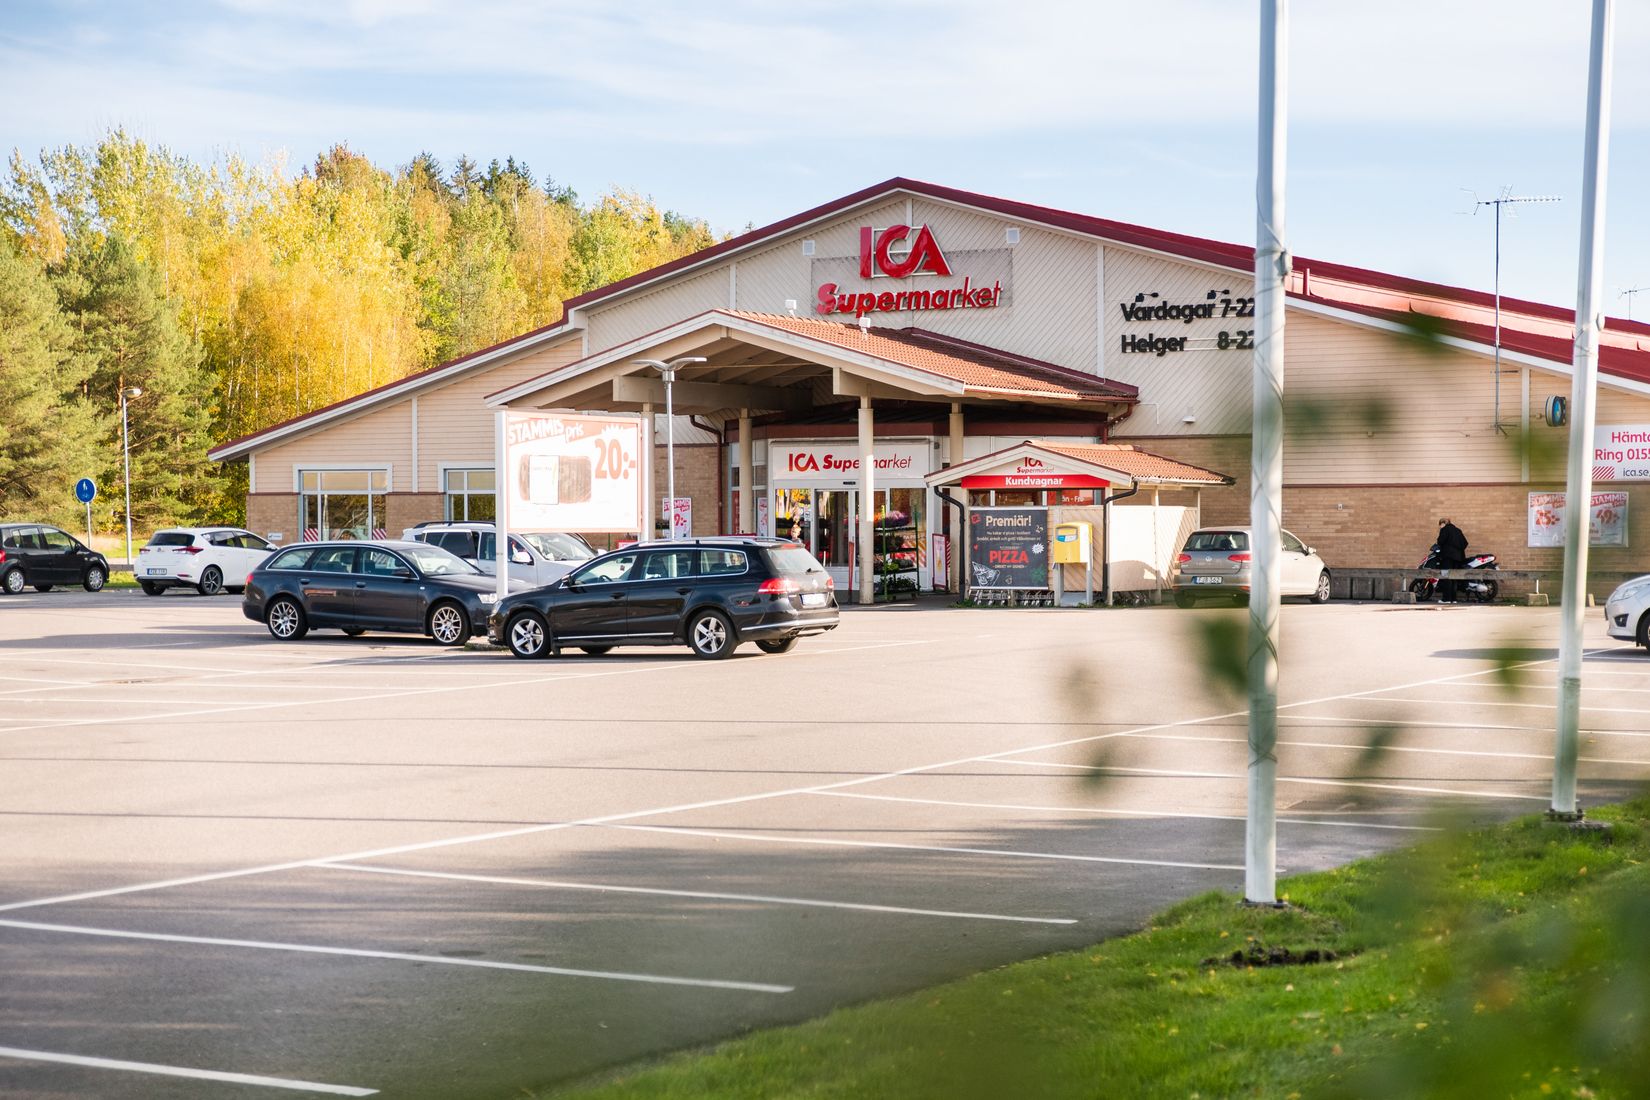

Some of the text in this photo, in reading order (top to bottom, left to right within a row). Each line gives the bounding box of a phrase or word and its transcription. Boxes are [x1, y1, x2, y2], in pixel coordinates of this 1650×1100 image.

[860, 223, 952, 279] ICA
[816, 277, 1002, 318] Supermarket
[1121, 301, 1215, 324] Vardagar
[1121, 333, 1187, 357] Helger
[509, 419, 564, 445] STAMMIS
[565, 423, 584, 443] pris
[594, 438, 636, 479] 20:-
[789, 453, 912, 472] ICA Supearket
[1024, 457, 1043, 467] ICA
[1595, 449, 1623, 463] Ring
[1005, 476, 1063, 487] Kundvagnar
[1623, 468, 1650, 477] ica.se
[985, 515, 1032, 527] Premiär!
[989, 550, 1029, 563] PIZZA
